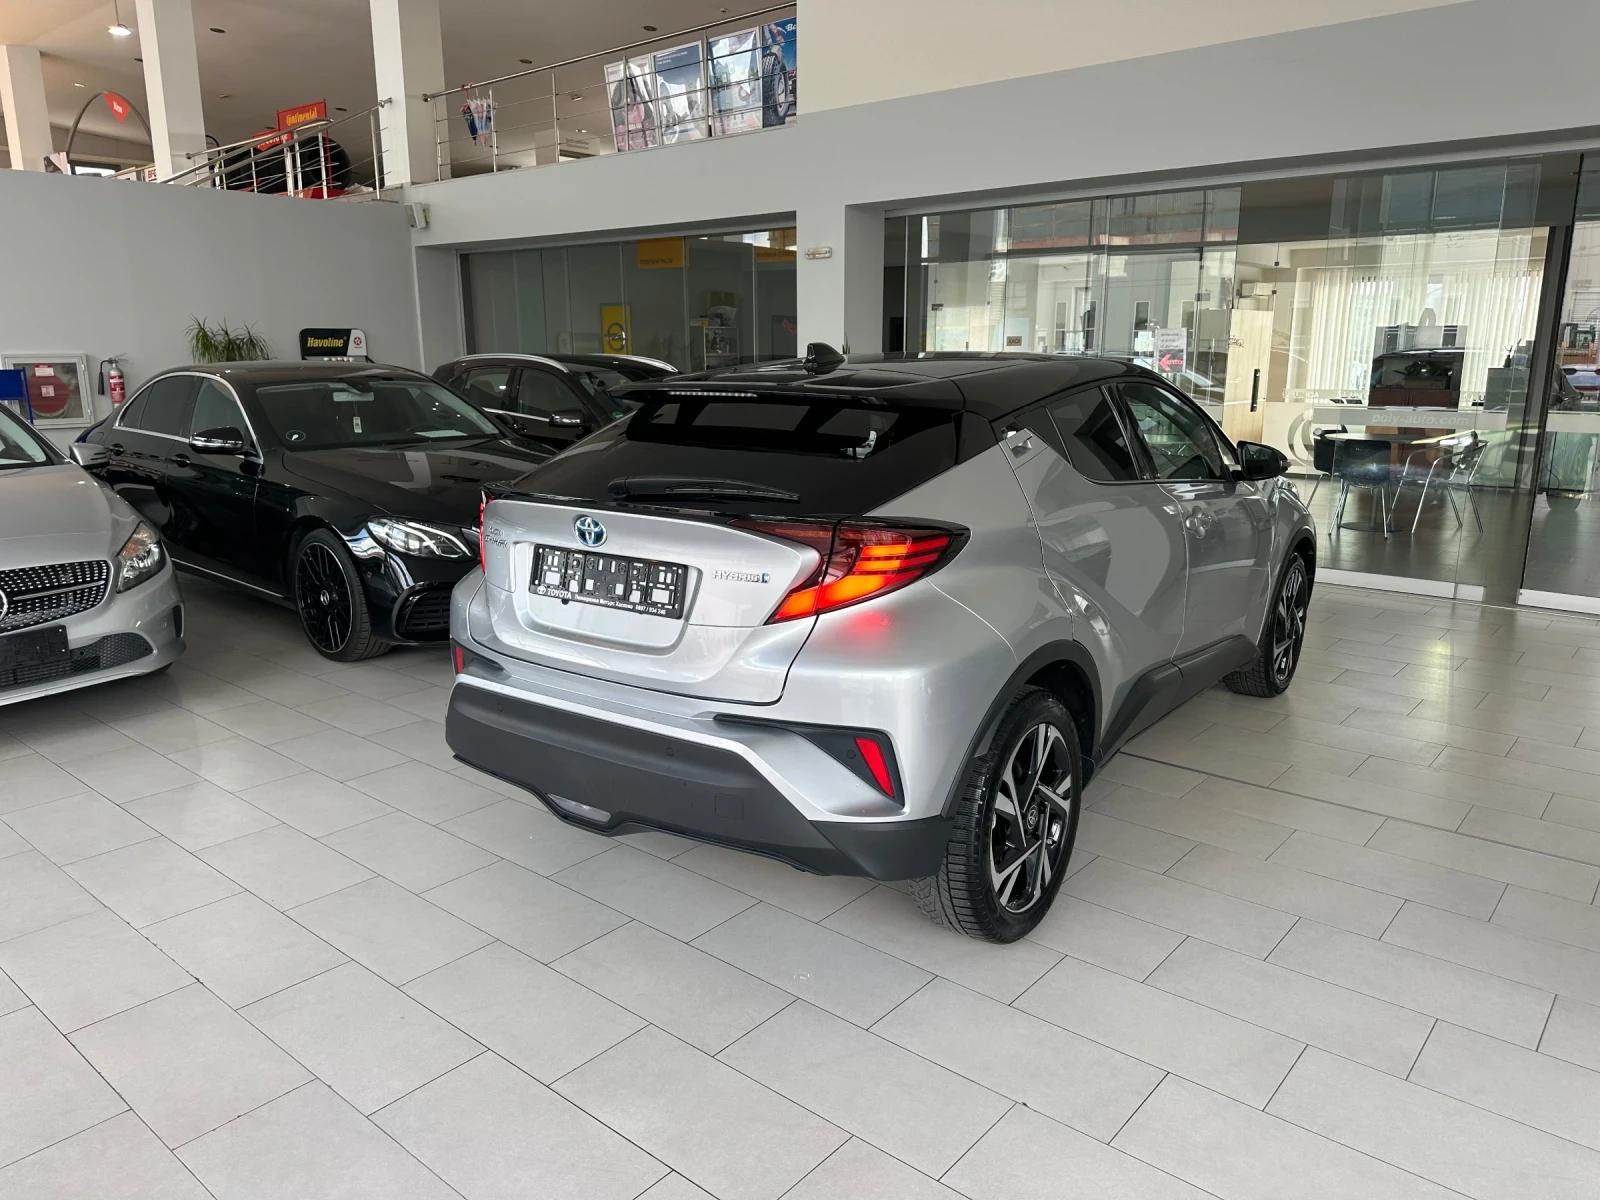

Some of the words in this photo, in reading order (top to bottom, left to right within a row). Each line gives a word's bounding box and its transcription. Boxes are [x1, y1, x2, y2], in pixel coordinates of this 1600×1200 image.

[286, 107, 318, 127] Continental
[307, 336, 344, 348] Havoline
[1371, 412, 1469, 425] poly-auto.com
[712, 569, 760, 583] HYBRID
[548, 588, 572, 599] TOYOTA
